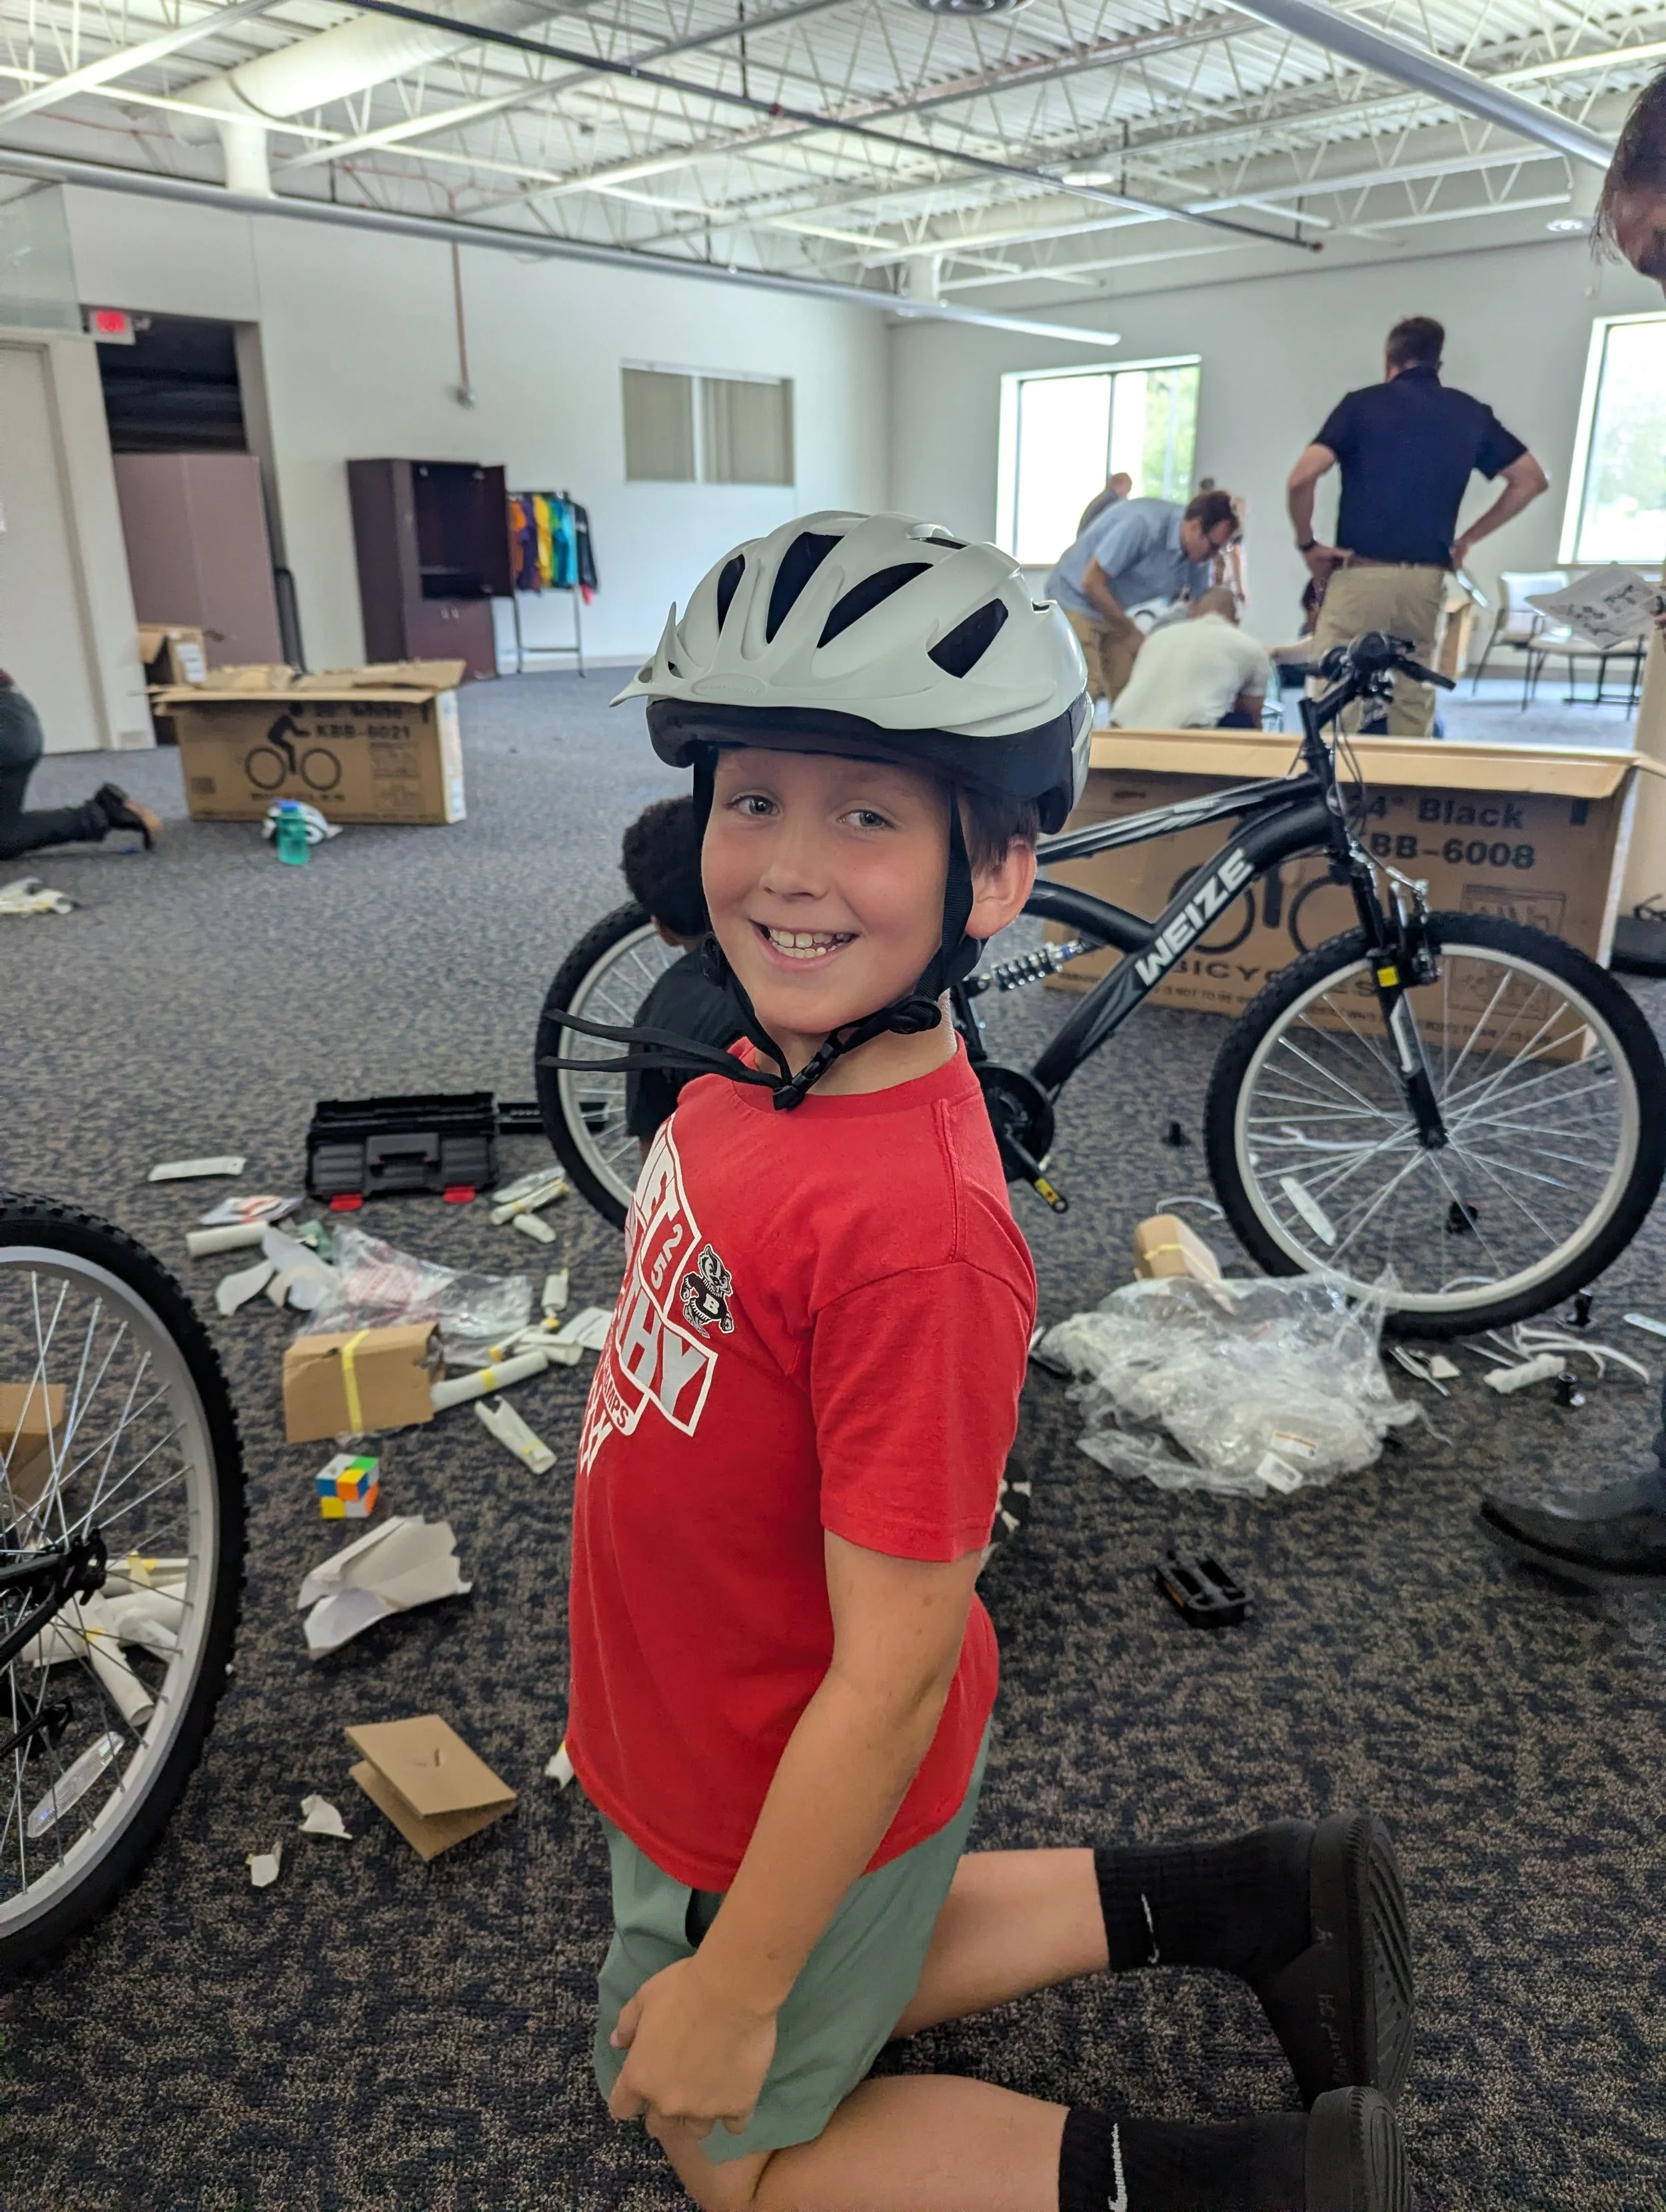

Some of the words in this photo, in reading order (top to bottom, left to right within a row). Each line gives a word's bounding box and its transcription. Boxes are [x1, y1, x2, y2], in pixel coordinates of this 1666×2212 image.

[1418, 798, 1523, 829] Black
[1359, 831, 1535, 869] BB-6008
[1134, 847, 1254, 987] WEIZE
[703, 1294, 720, 1315] B
